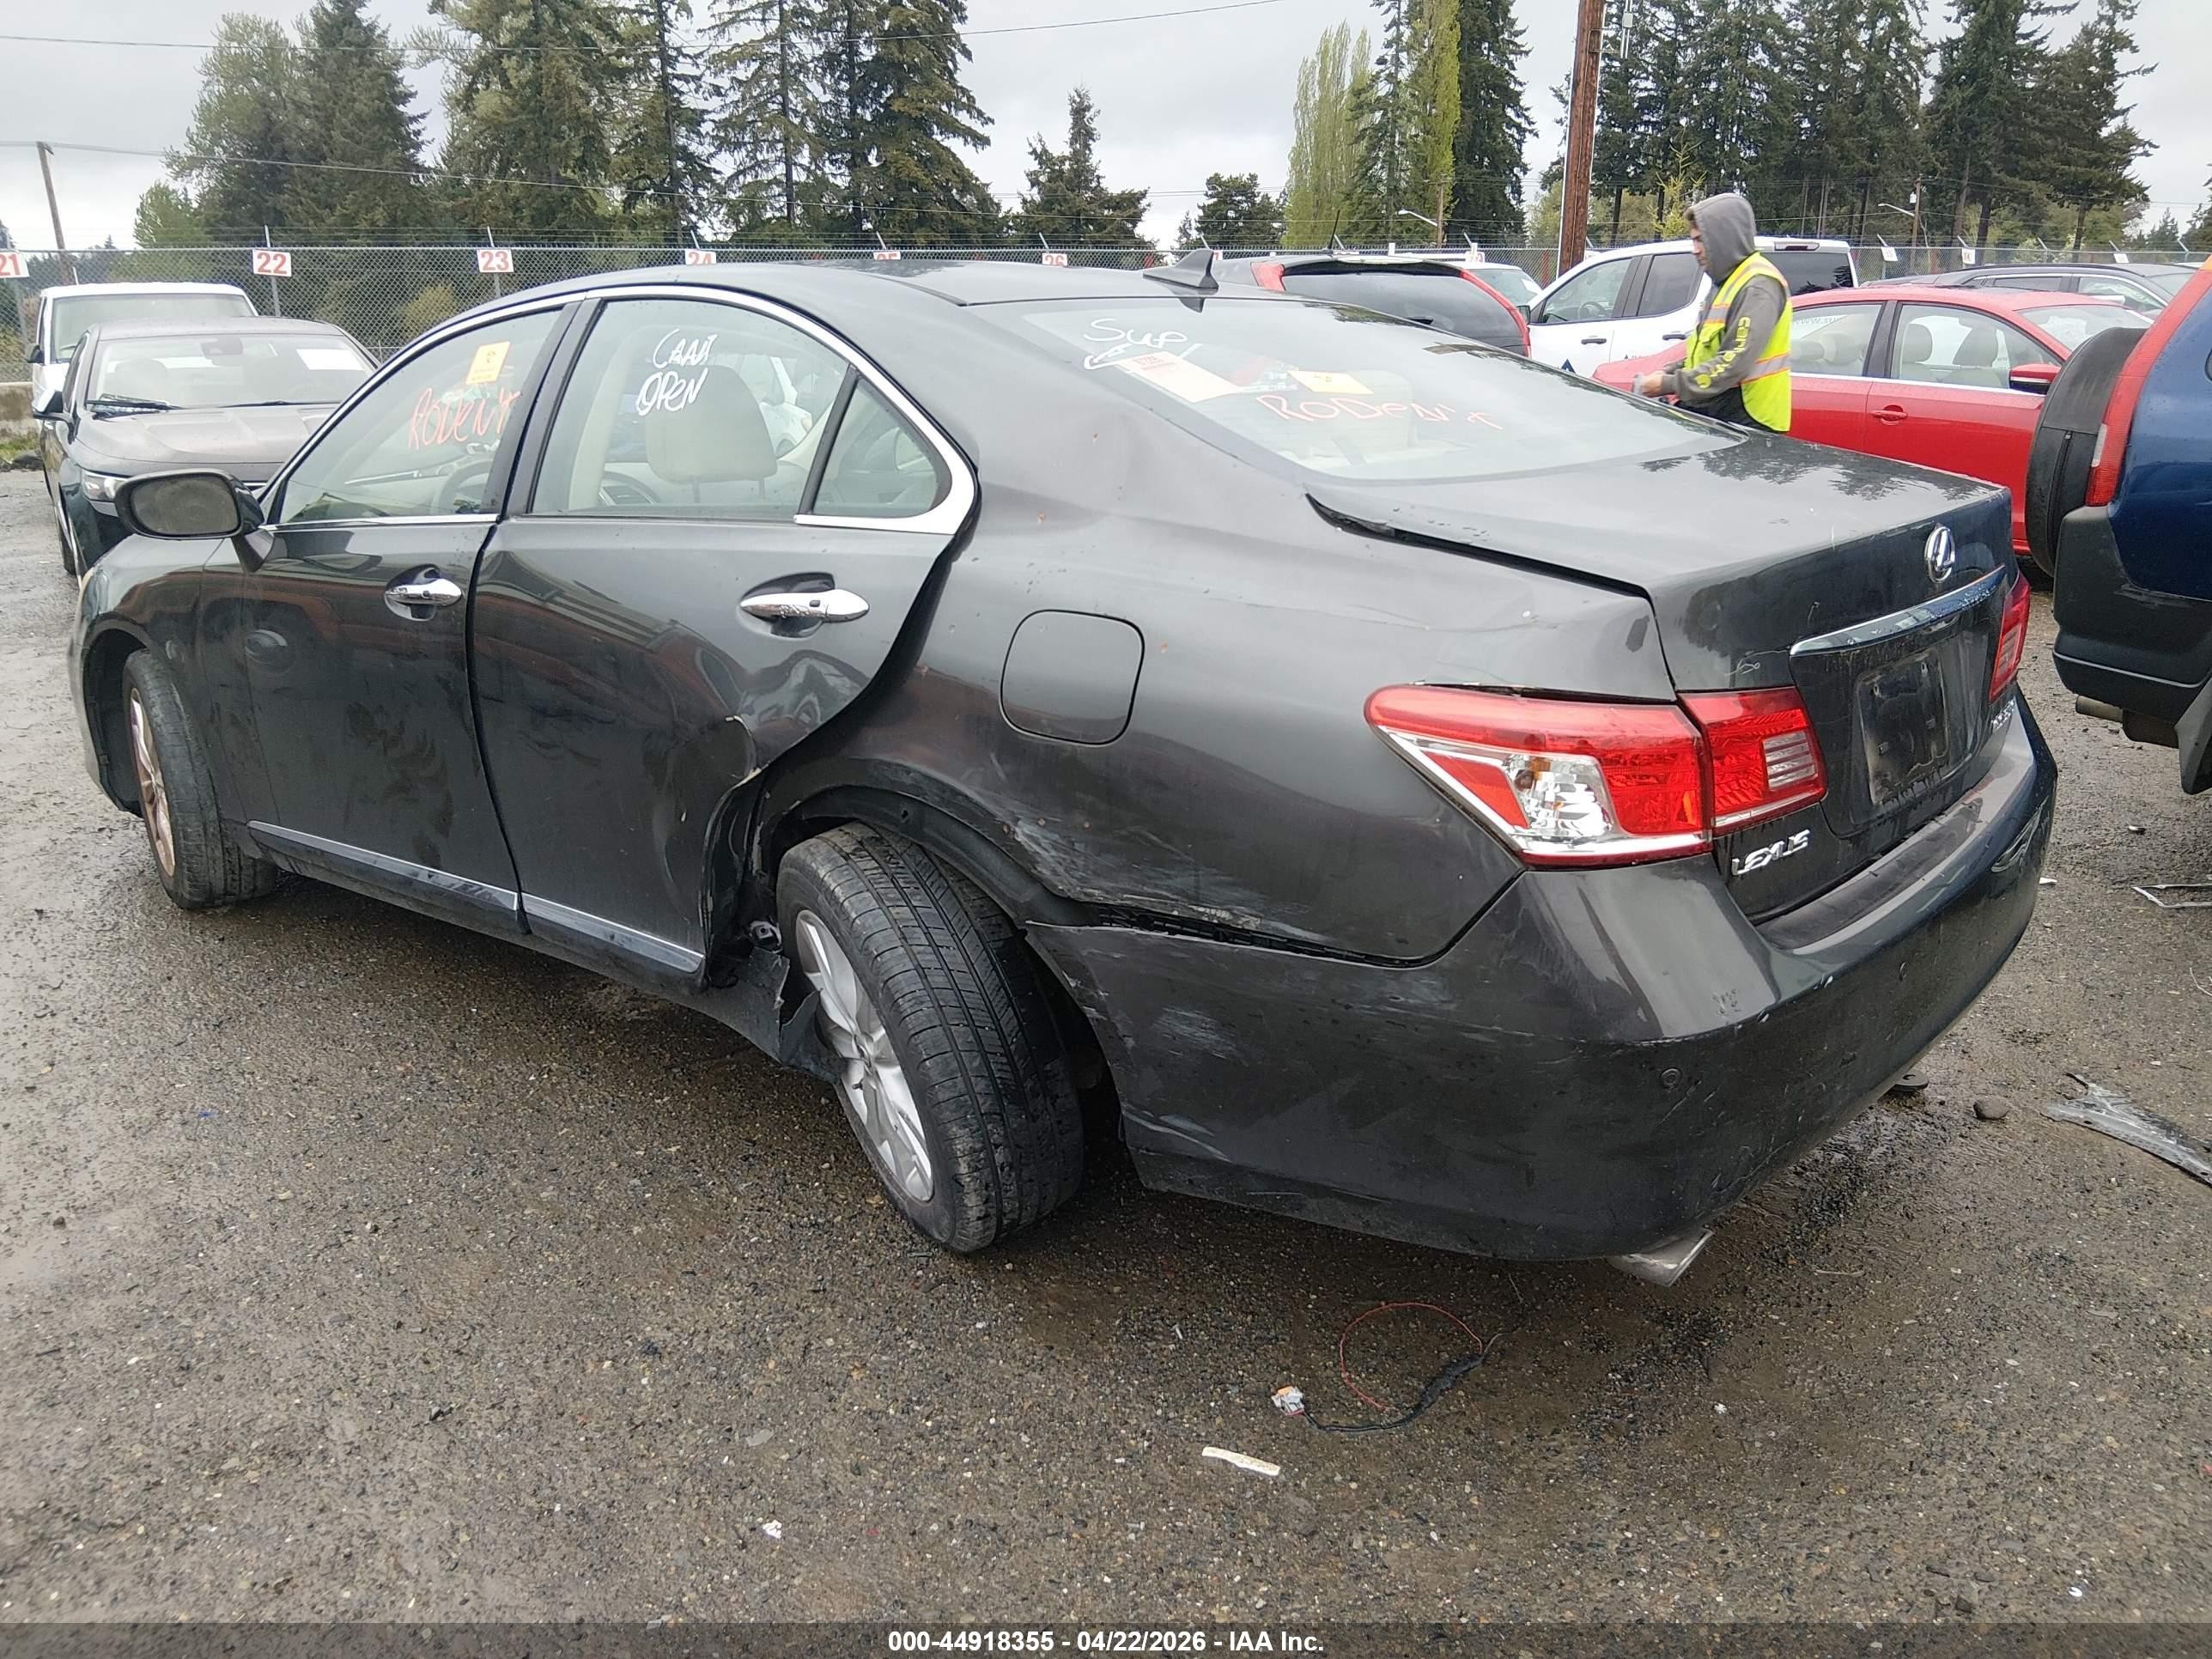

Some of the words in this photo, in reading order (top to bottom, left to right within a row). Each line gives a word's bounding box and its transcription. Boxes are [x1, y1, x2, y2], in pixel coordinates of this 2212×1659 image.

[0, 252, 21, 276] 21
[257, 252, 288, 274] 22
[480, 251, 509, 271] 23
[1730, 829, 1811, 876] LEXUS
